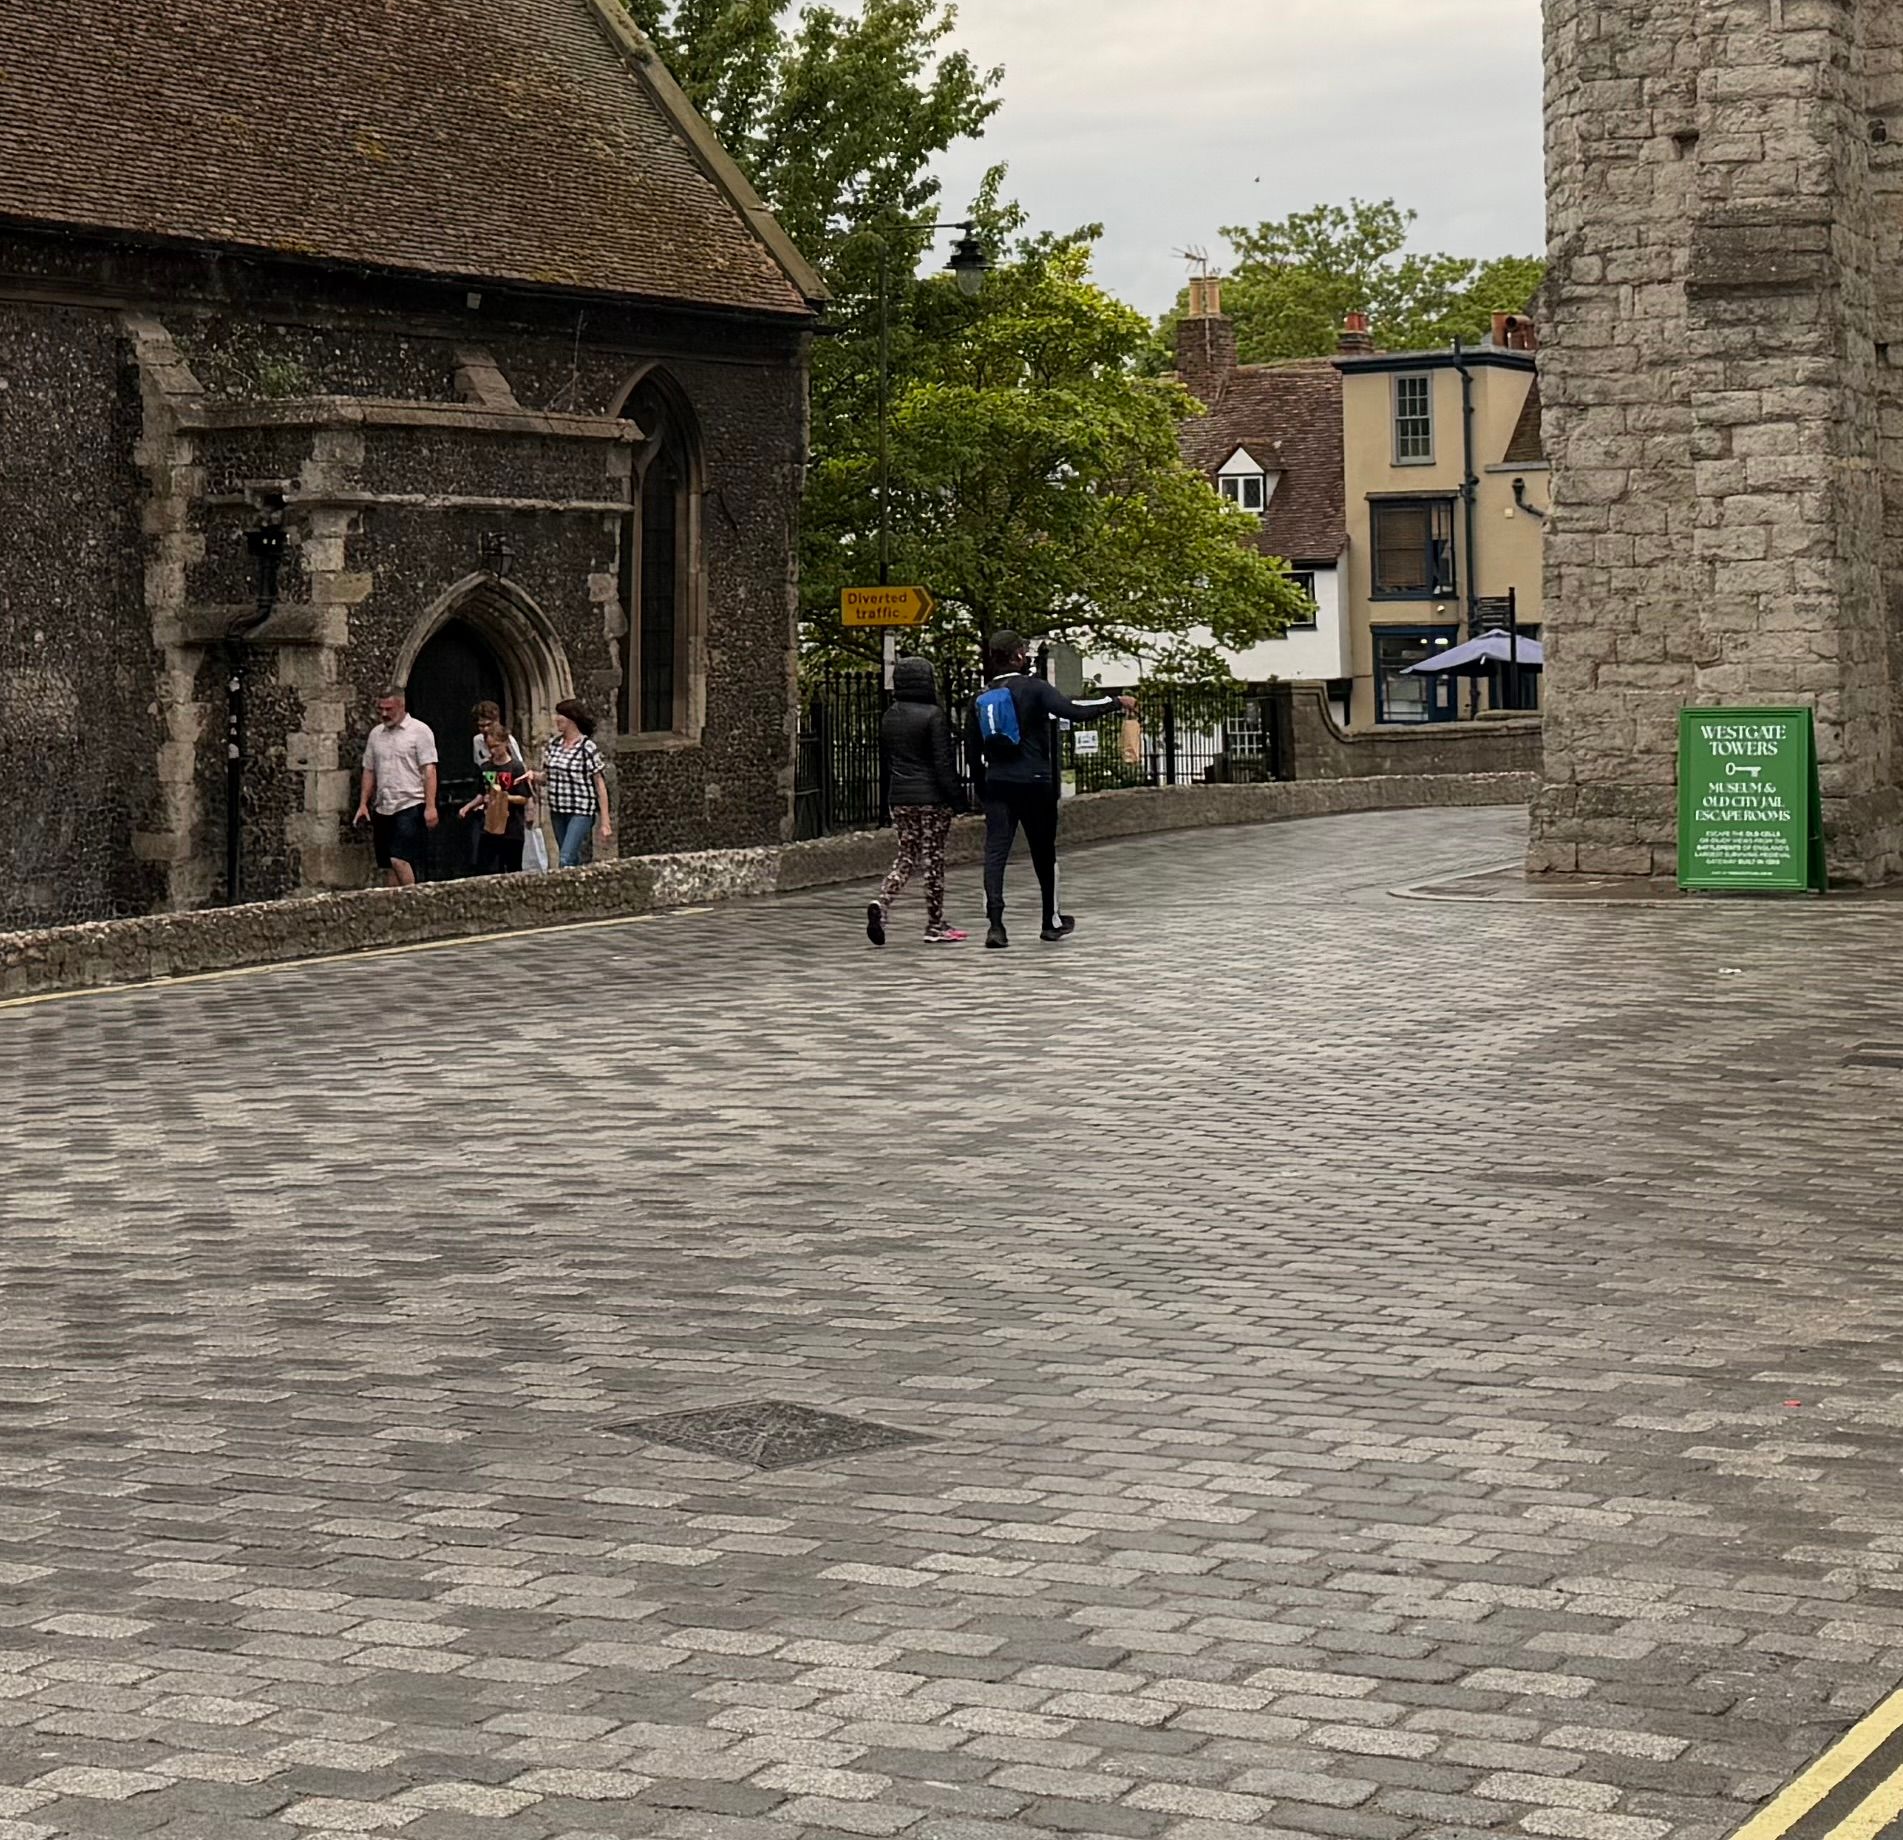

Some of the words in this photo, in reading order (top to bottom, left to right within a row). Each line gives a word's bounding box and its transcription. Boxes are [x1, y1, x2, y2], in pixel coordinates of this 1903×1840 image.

[848, 592, 908, 605] Diverted
[856, 607, 900, 619] traffic
[1701, 725, 1787, 740] WESTGATE
[1709, 741, 1778, 756] TOWERS
[1709, 782, 1762, 793] MUSEUM
[1763, 782, 1777, 793] &
[1702, 796, 1730, 807] OLD
[1731, 796, 1757, 807] CITY
[1760, 796, 1785, 808] JAIL
[1695, 810, 1742, 821] ESCAPE
[1743, 810, 1791, 821] ROOMS
